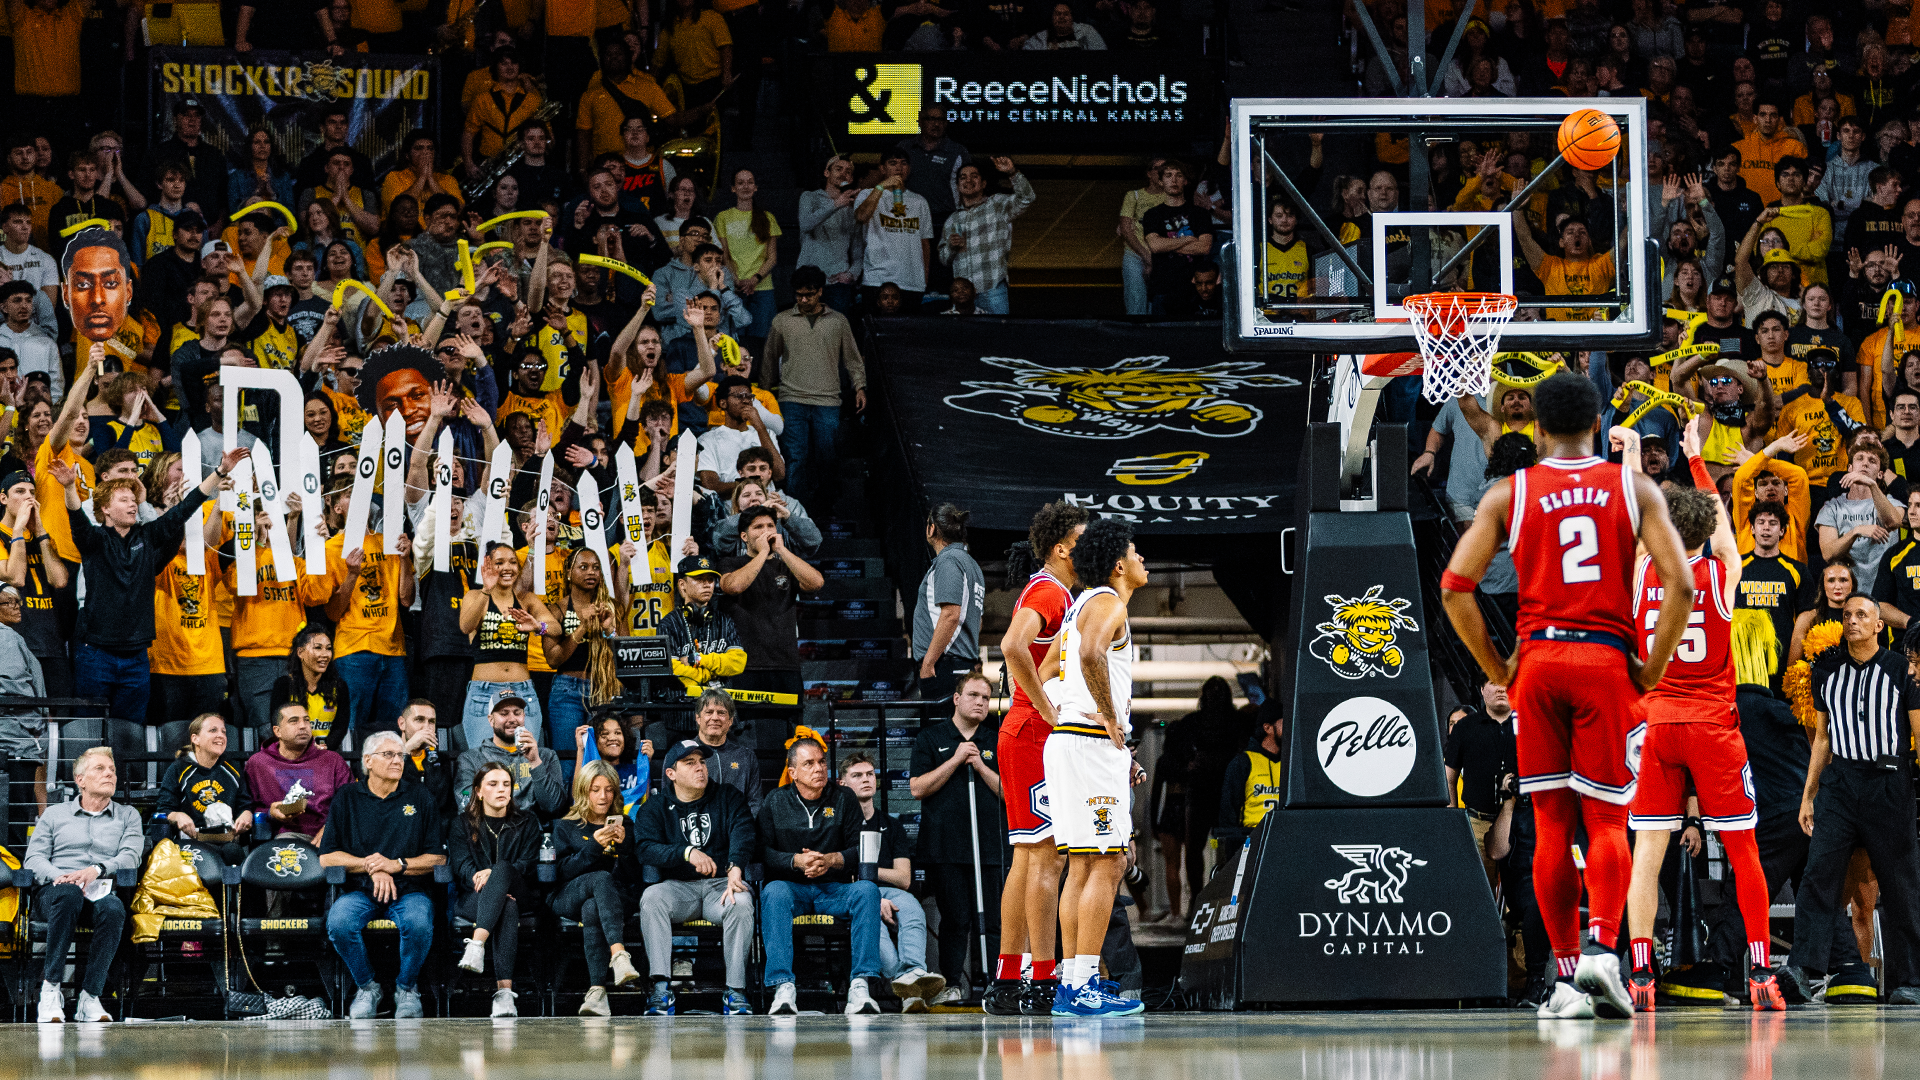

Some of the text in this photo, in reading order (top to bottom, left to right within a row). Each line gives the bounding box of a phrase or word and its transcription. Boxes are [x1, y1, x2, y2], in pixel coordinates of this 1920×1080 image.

[340, 68, 430, 100] SOUND
[934, 74, 1188, 104] ReeceNichols
[946, 109, 1185, 122] OUTH CENTRAL KANSAS
[1268, 271, 1306, 281] hockers
[1254, 327, 1294, 336] SPALDING
[1665, 345, 1719, 360] FEAR THE WHEA
[1080, 412, 1144, 432] WSU
[1804, 411, 1825, 421] FEAR
[1812, 457, 1838, 468] WHEAT
[1064, 493, 1279, 512] EQUITY
[1539, 487, 1610, 514] ELOHIM
[1558, 515, 1601, 584] 2
[264, 585, 296, 601] STATE
[629, 580, 672, 594] hockers
[1740, 581, 1787, 595] WICHITA
[1647, 587, 1706, 604] MOTI
[1746, 594, 1779, 607] STATE
[26, 596, 53, 609] STATE
[362, 606, 389, 618] WHEAT
[633, 598, 662, 630] 26
[181, 617, 208, 629] WHEAT
[618, 648, 641, 661] 917
[1349, 651, 1368, 672] WSU
[730, 691, 775, 702] THE WHEAT
[1320, 714, 1411, 768] Pella
[1088, 796, 1117, 806] MTXE
[161, 920, 202, 931] HOCKERS
[261, 919, 308, 931] SHOCKERS
[793, 914, 834, 925] HOCKERS
[1299, 911, 1452, 937] DYNAMO
[1323, 942, 1424, 955] CAPITAL
